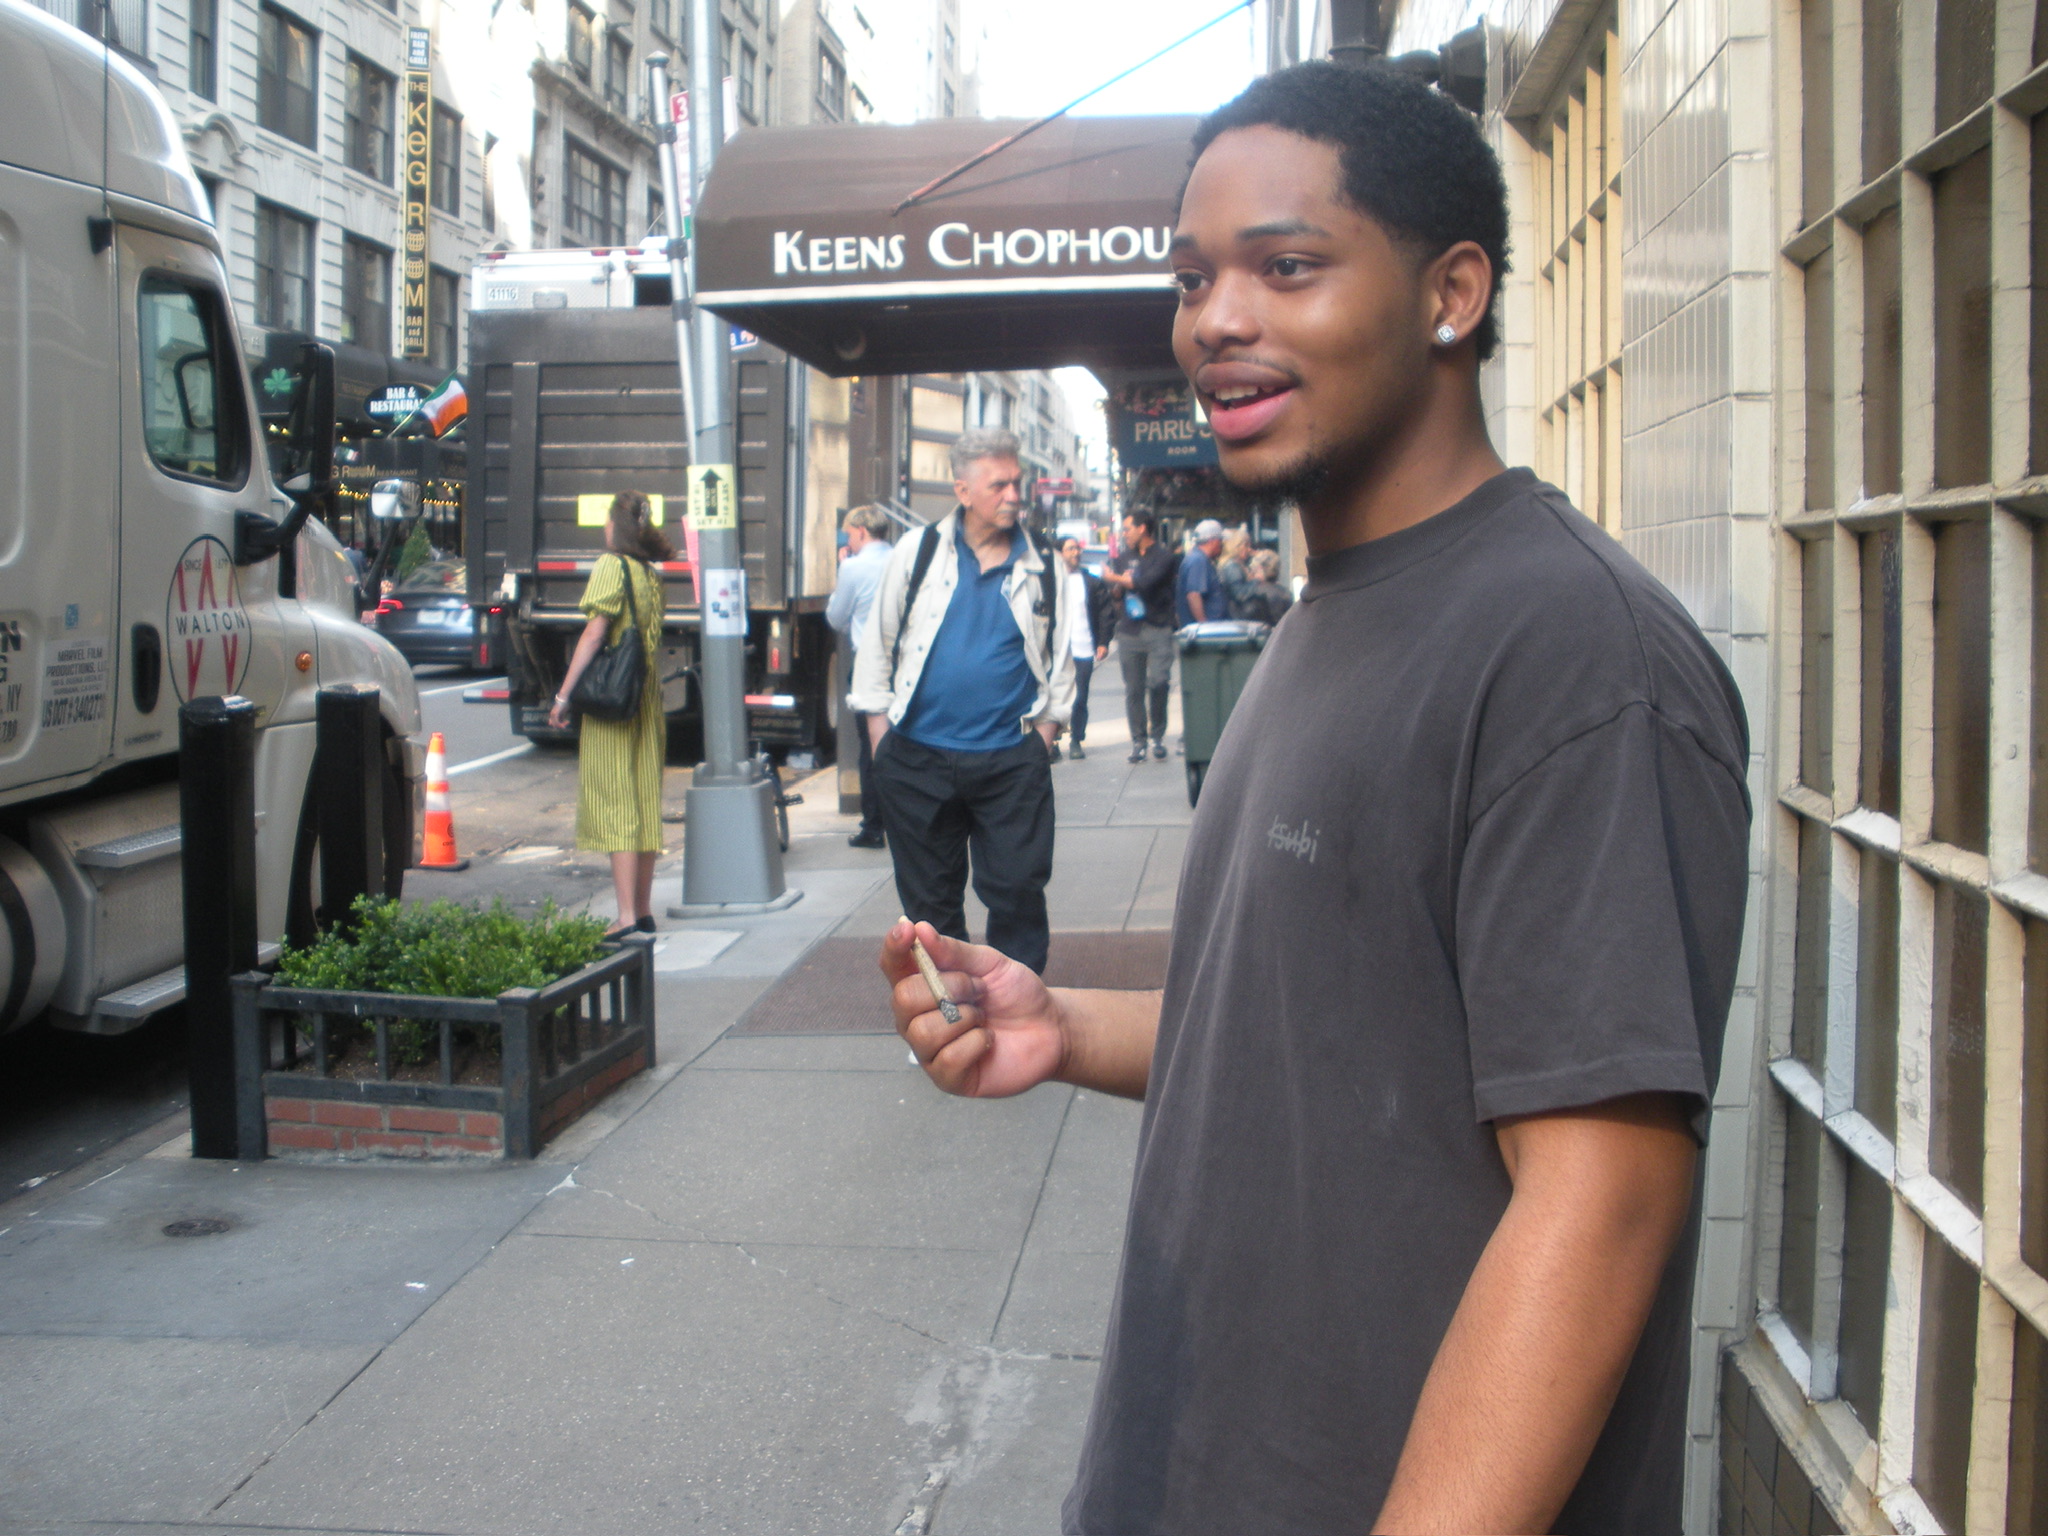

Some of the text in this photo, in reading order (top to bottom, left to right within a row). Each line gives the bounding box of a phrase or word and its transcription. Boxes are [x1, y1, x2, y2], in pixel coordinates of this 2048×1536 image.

[409, 82, 427, 92] THE
[774, 222, 1171, 274] KEENS CHOPHOU
[406, 315, 422, 326] BAR
[386, 387, 405, 399] BAR
[408, 386, 416, 398] &
[1168, 446, 1198, 456] ROOM
[184, 559, 201, 572] SINCE
[176, 611, 245, 636] WALTON
[58, 647, 103, 662] MARVEL FILM
[7, 683, 22, 712] NY
